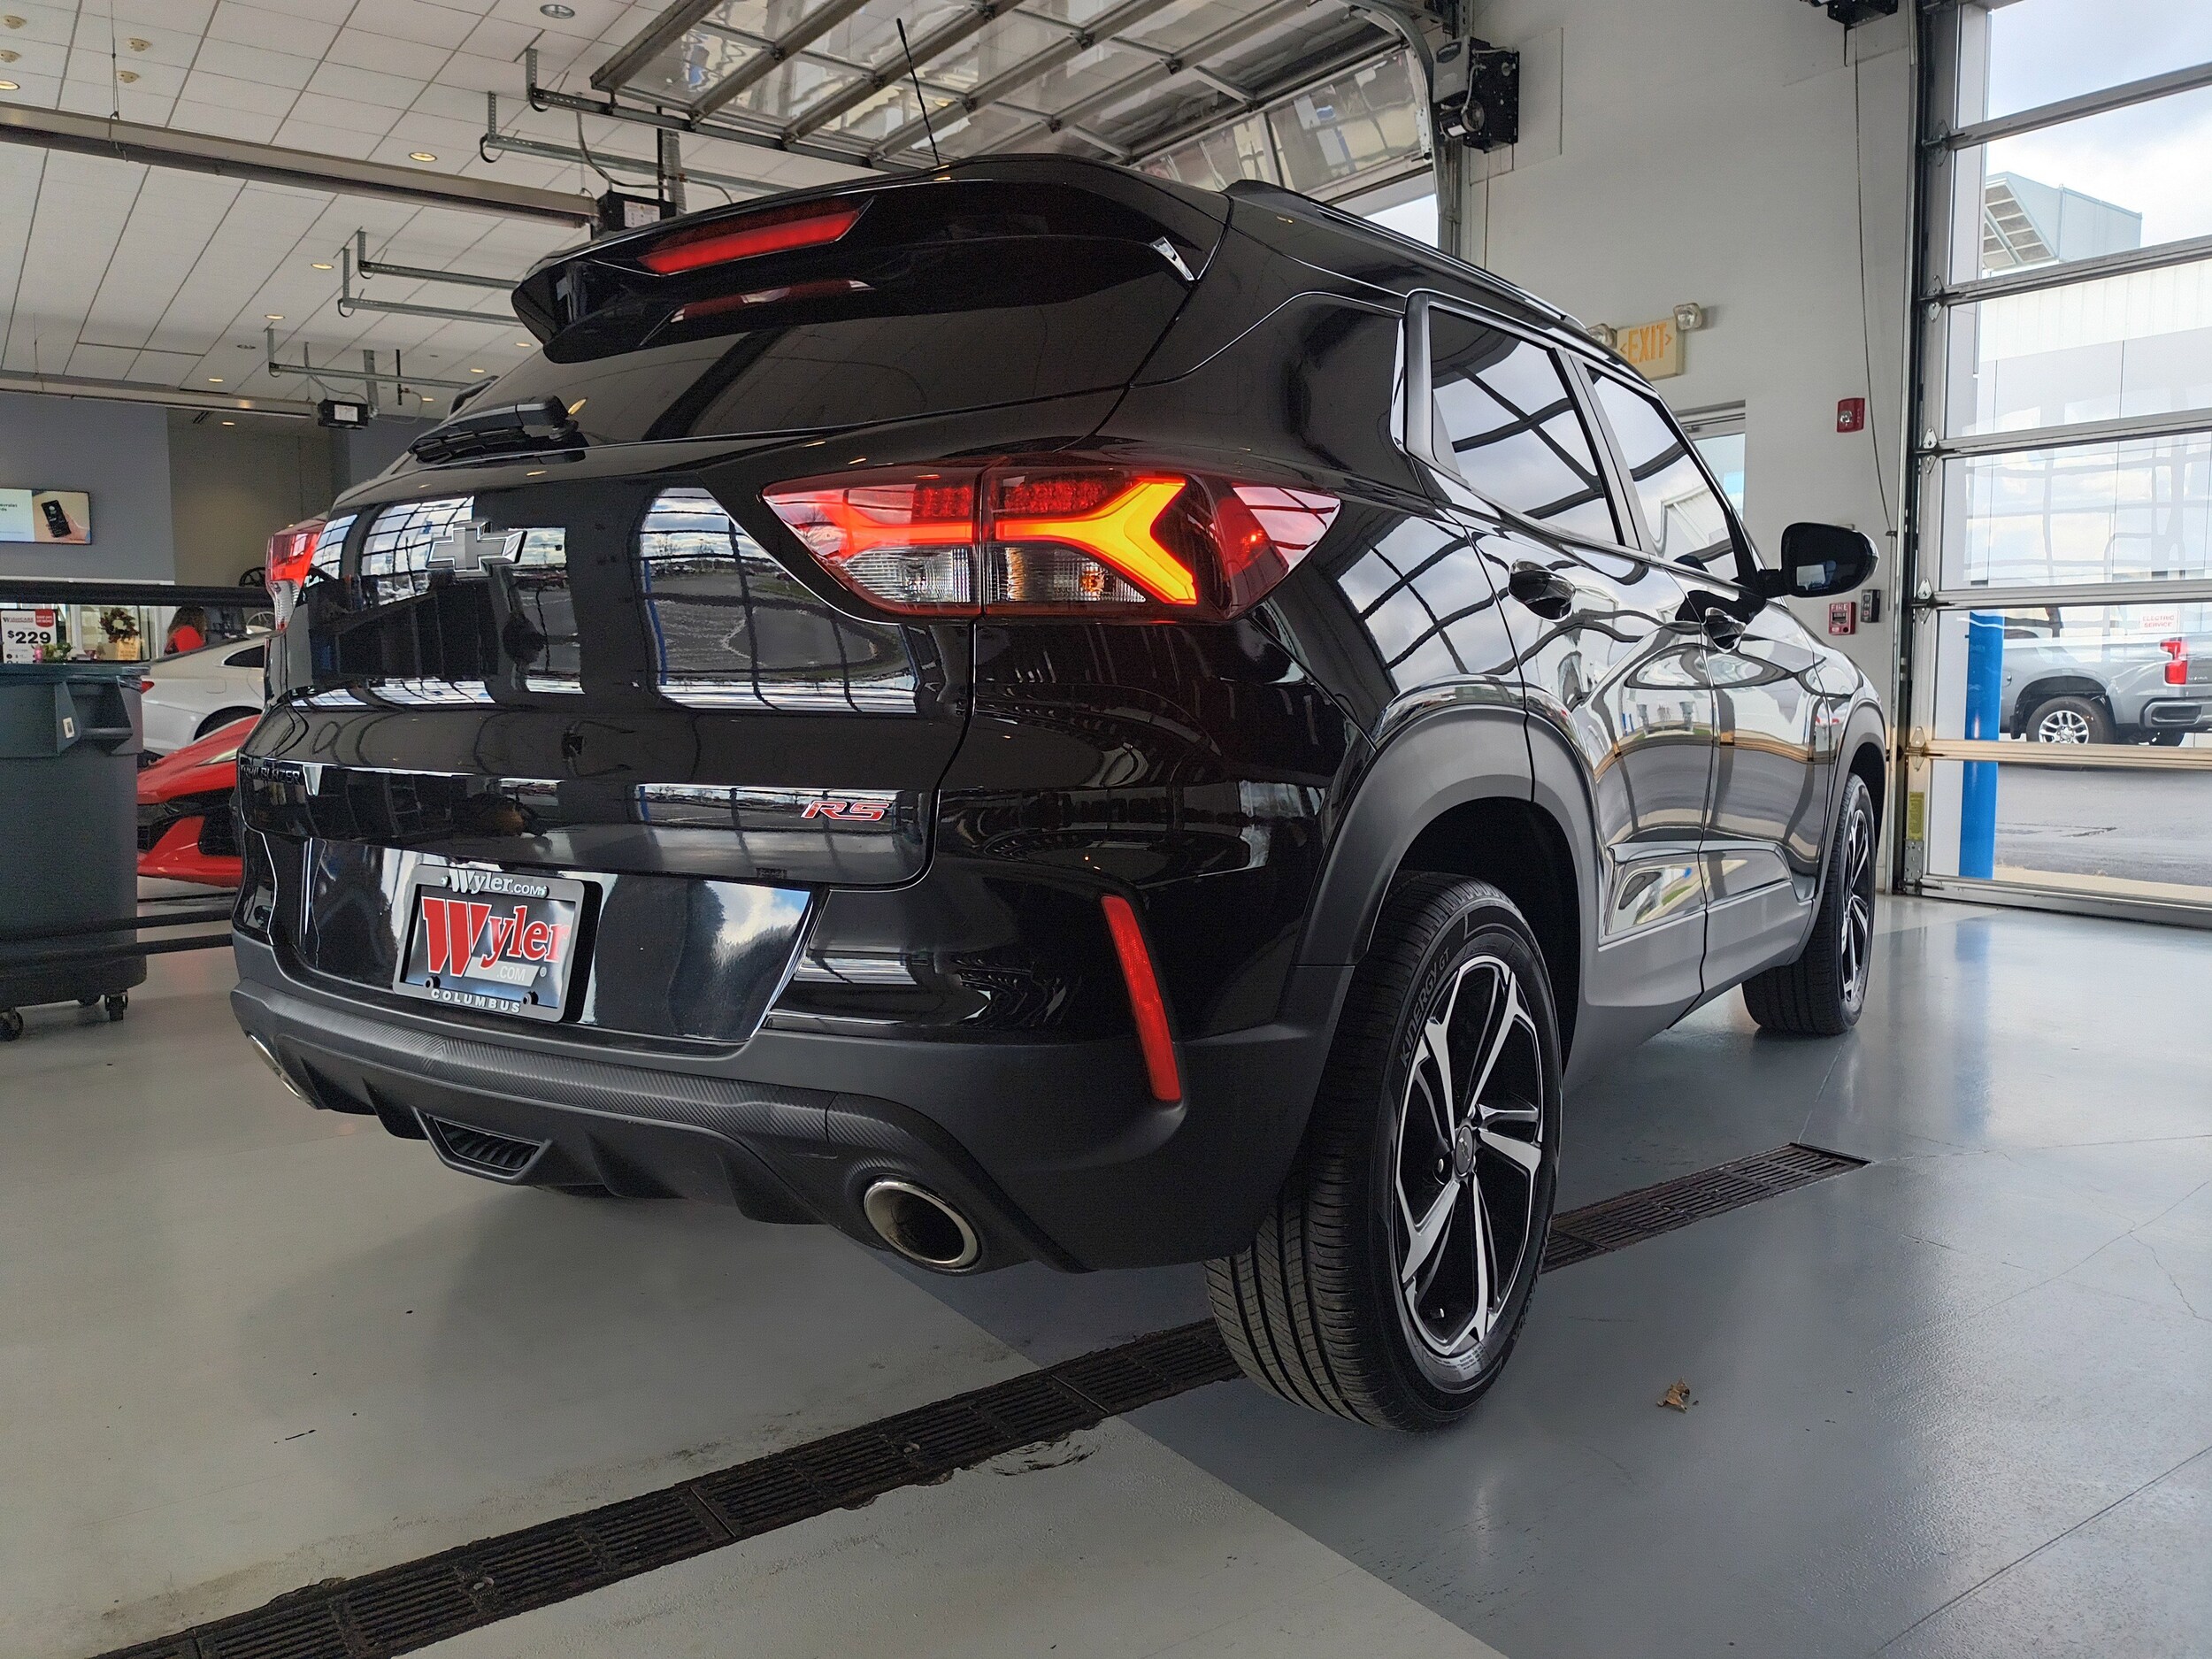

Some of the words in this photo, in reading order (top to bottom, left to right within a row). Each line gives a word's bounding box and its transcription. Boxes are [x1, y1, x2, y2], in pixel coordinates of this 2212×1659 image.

[1628, 321, 1667, 365] EXIT
[7, 630, 51, 644] $229
[801, 800, 890, 822] RS
[421, 895, 571, 978] Wyler
[430, 988, 520, 1013] COLUMBUS
[1401, 962, 1437, 1068] KINERGY
[1439, 947, 1449, 971] GT
